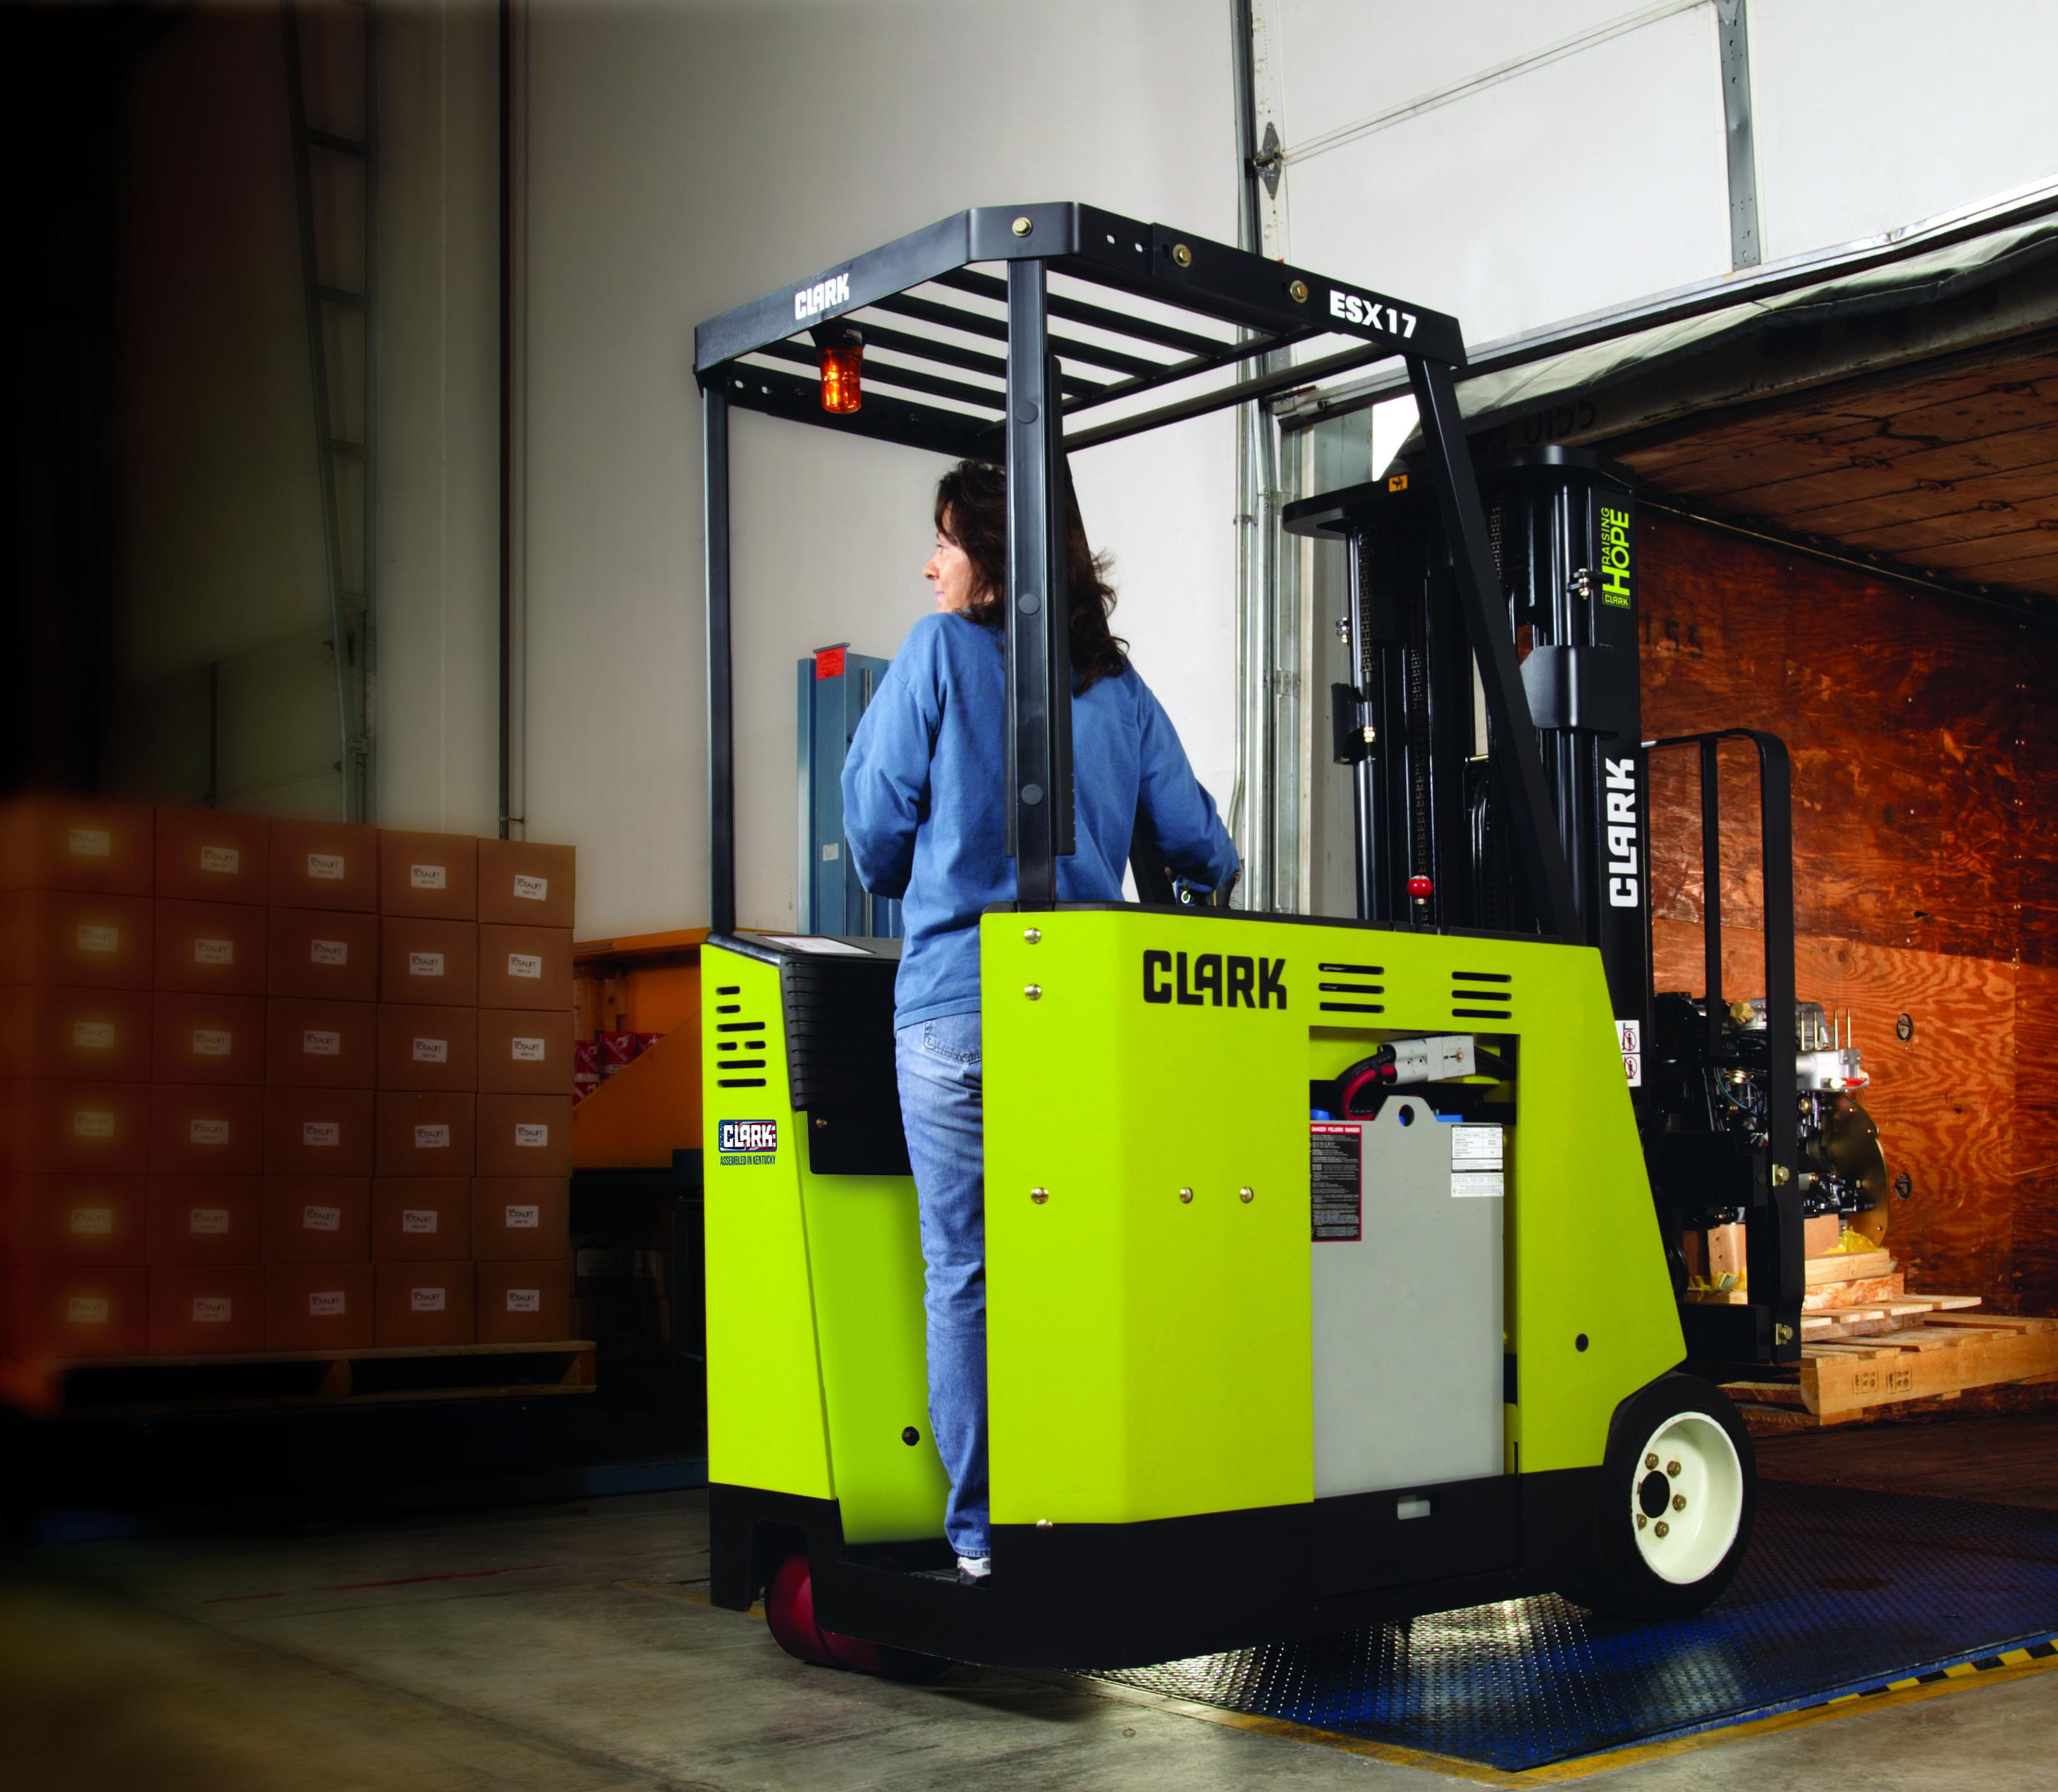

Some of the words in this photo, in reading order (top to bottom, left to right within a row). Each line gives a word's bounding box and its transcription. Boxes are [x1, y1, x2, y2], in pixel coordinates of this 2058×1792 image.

[795, 273, 850, 320] CLARK
[1330, 290, 1383, 331] ESX
[1386, 308, 1416, 338] 17
[1601, 508, 1611, 565] RAISING
[1602, 508, 1630, 596] HOPE
[1605, 594, 1629, 606] CLARK
[1605, 758, 1639, 908] CLARK
[1144, 950, 1287, 1010] CLARK
[723, 1124, 773, 1147] CLARK
[720, 1156, 746, 1165] ASSEMBLED
[747, 1156, 752, 1165] IN
[753, 1155, 776, 1165] KENTUCKY
